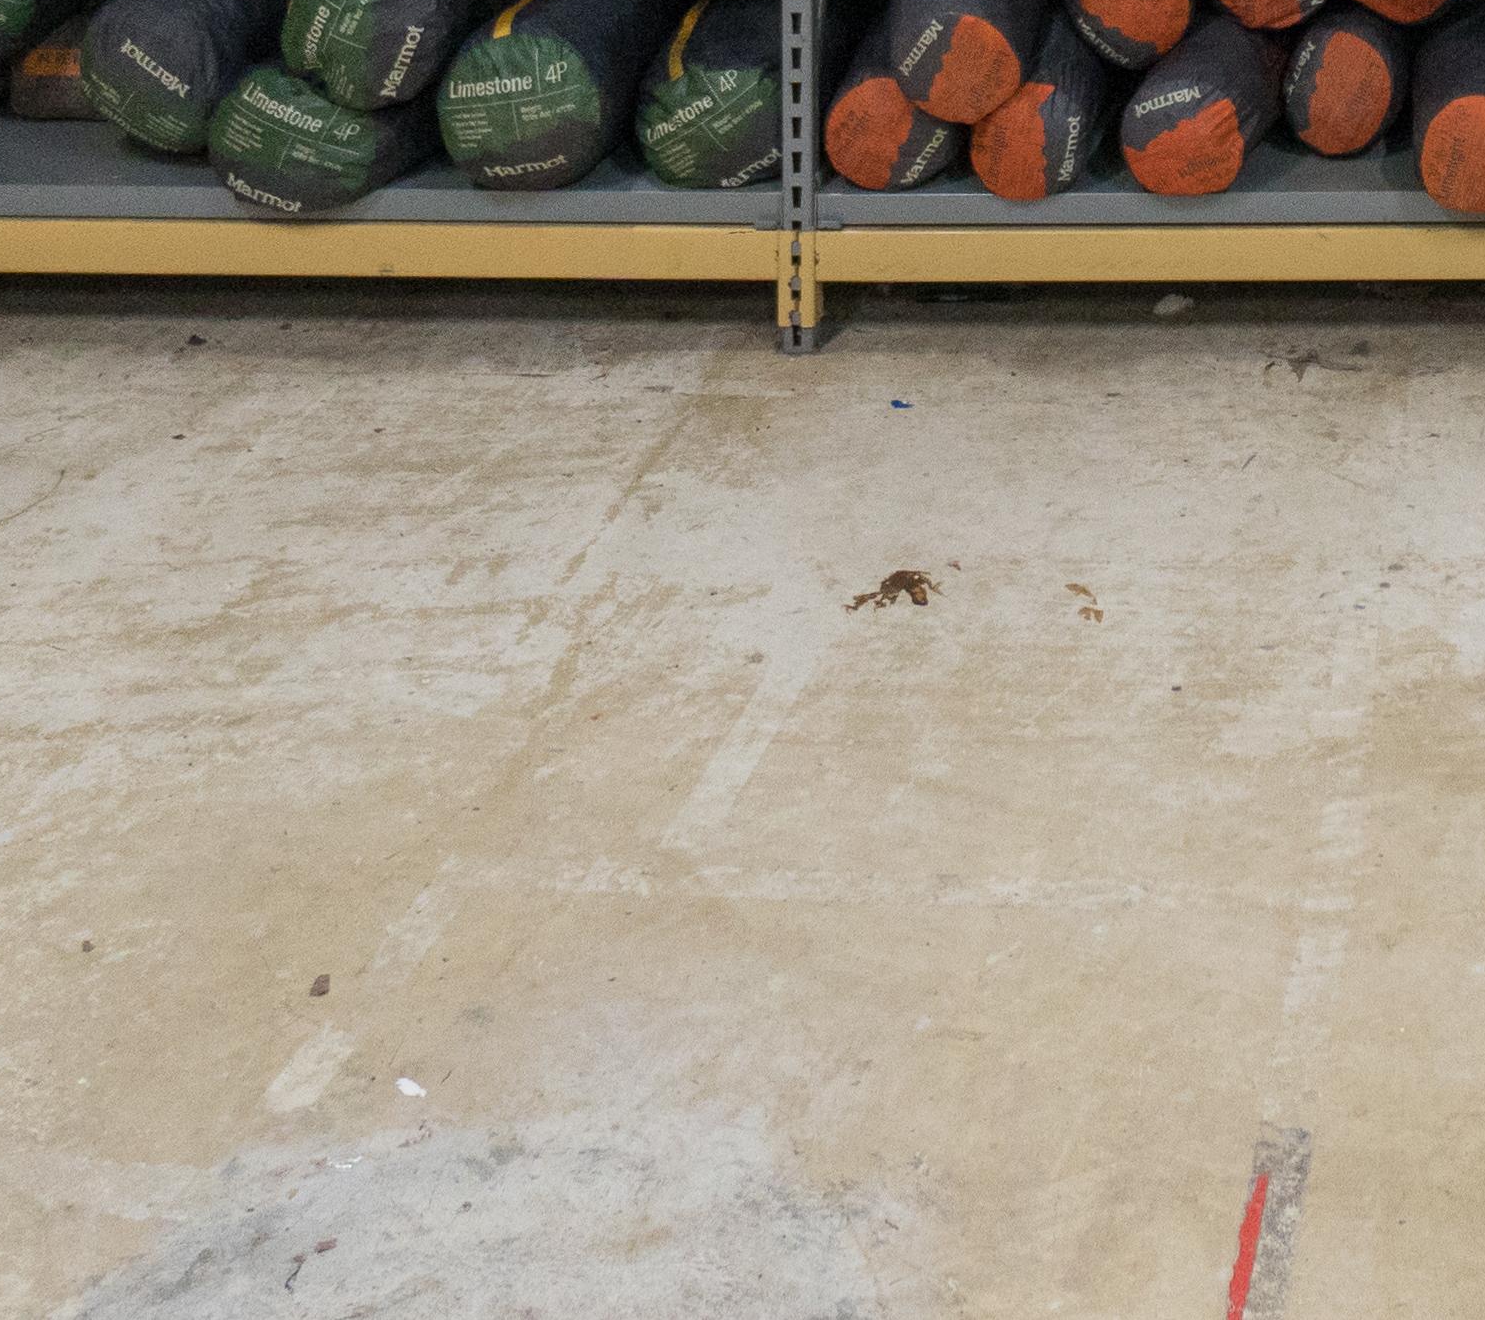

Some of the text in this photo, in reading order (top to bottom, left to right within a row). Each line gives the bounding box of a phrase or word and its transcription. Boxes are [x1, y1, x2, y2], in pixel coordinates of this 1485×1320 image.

[120, 37, 191, 99] Marmot
[379, 24, 425, 98] Marmot
[898, 18, 945, 78] Marmot
[449, 60, 568, 100] Limestone 4P
[646, 95, 715, 145] Limestone
[718, 68, 739, 93] 4P
[1134, 85, 1202, 119] Marmot
[242, 81, 323, 134] Limestone
[333, 122, 361, 142] 4P
[483, 154, 568, 178] Marmot
[899, 128, 948, 186] Marmot
[1057, 114, 1082, 182] Marmot
[226, 172, 303, 213] Marmot
